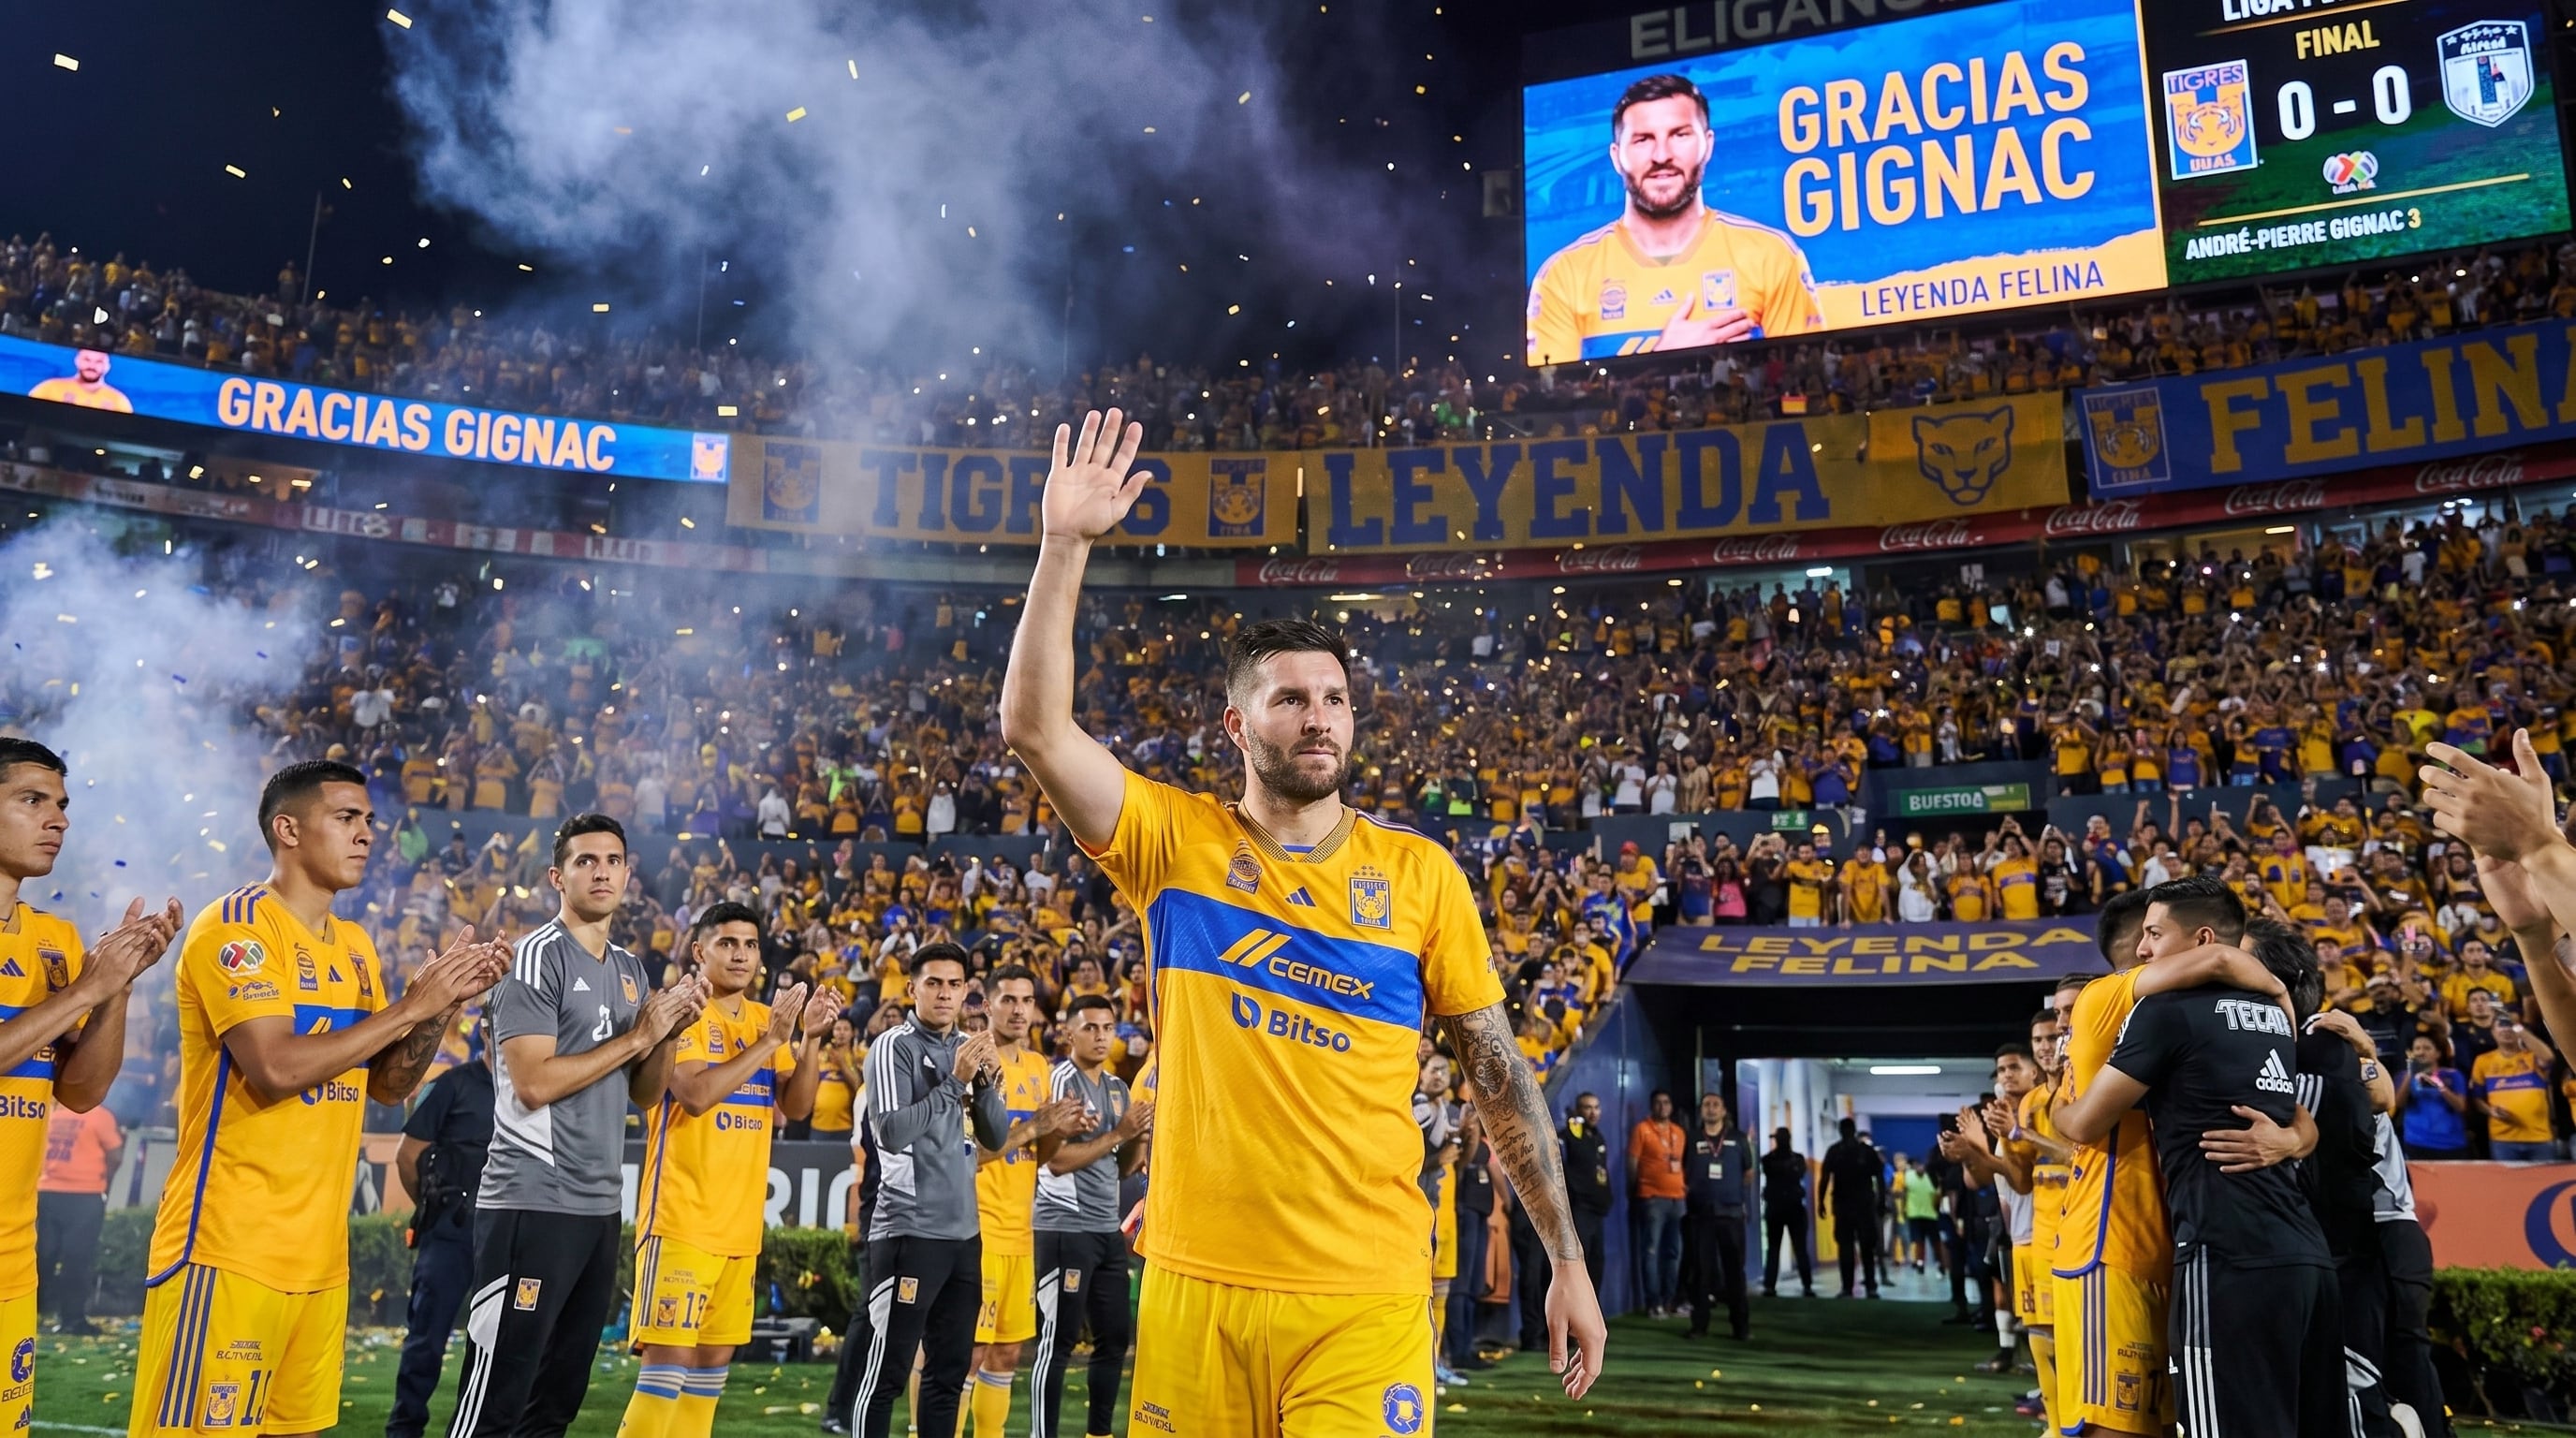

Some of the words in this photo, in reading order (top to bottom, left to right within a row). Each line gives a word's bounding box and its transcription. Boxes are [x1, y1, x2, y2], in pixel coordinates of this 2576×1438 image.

[2295, 20, 2380, 60] FINAL
[1778, 41, 2090, 154] GRACIAS
[2169, 65, 2245, 93] TIGRES
[2277, 81, 2316, 140] 0
[2372, 65, 2412, 125] 0
[1782, 117, 2096, 238] GIGNAC
[2186, 219, 2327, 261] ANDRÉ-PIERRE
[2330, 209, 2405, 241] GIGNAC
[2407, 207, 2422, 229] 3
[1862, 272, 1991, 318] LEYENDA
[1998, 260, 2105, 309] FELINA
[216, 376, 433, 451] GRACIAS
[444, 408, 618, 472] GIGNAC
[1325, 422, 1831, 547] LEYENDA
[1699, 928, 2094, 955] LEYENDA
[1730, 950, 2041, 976] FELINA
[1267, 956, 1375, 1001] CEMEX
[1267, 1009, 1352, 1053] Bitso
[326, 1081, 359, 1104] Bitso
